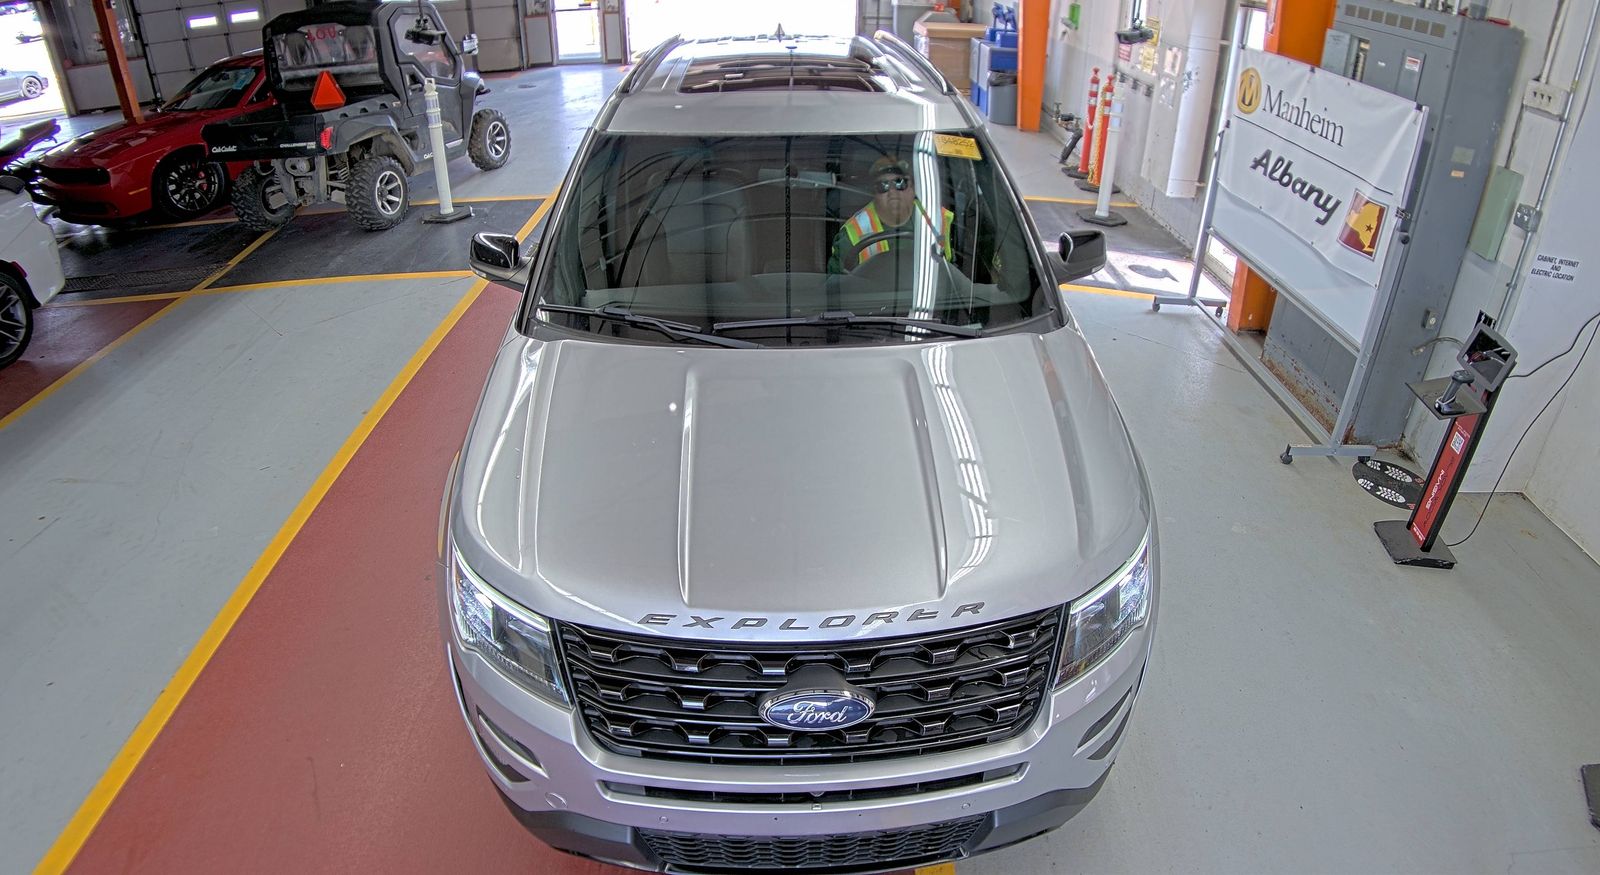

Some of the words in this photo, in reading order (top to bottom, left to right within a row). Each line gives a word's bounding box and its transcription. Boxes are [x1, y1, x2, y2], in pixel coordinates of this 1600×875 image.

[1262, 84, 1344, 147] Manheim
[1250, 148, 1342, 226] Albany
[1552, 272, 1574, 281] LOCATION
[1558, 259, 1579, 268] INTERNET
[637, 601, 985, 631] EXPLORER
[787, 700, 848, 725] Ford
